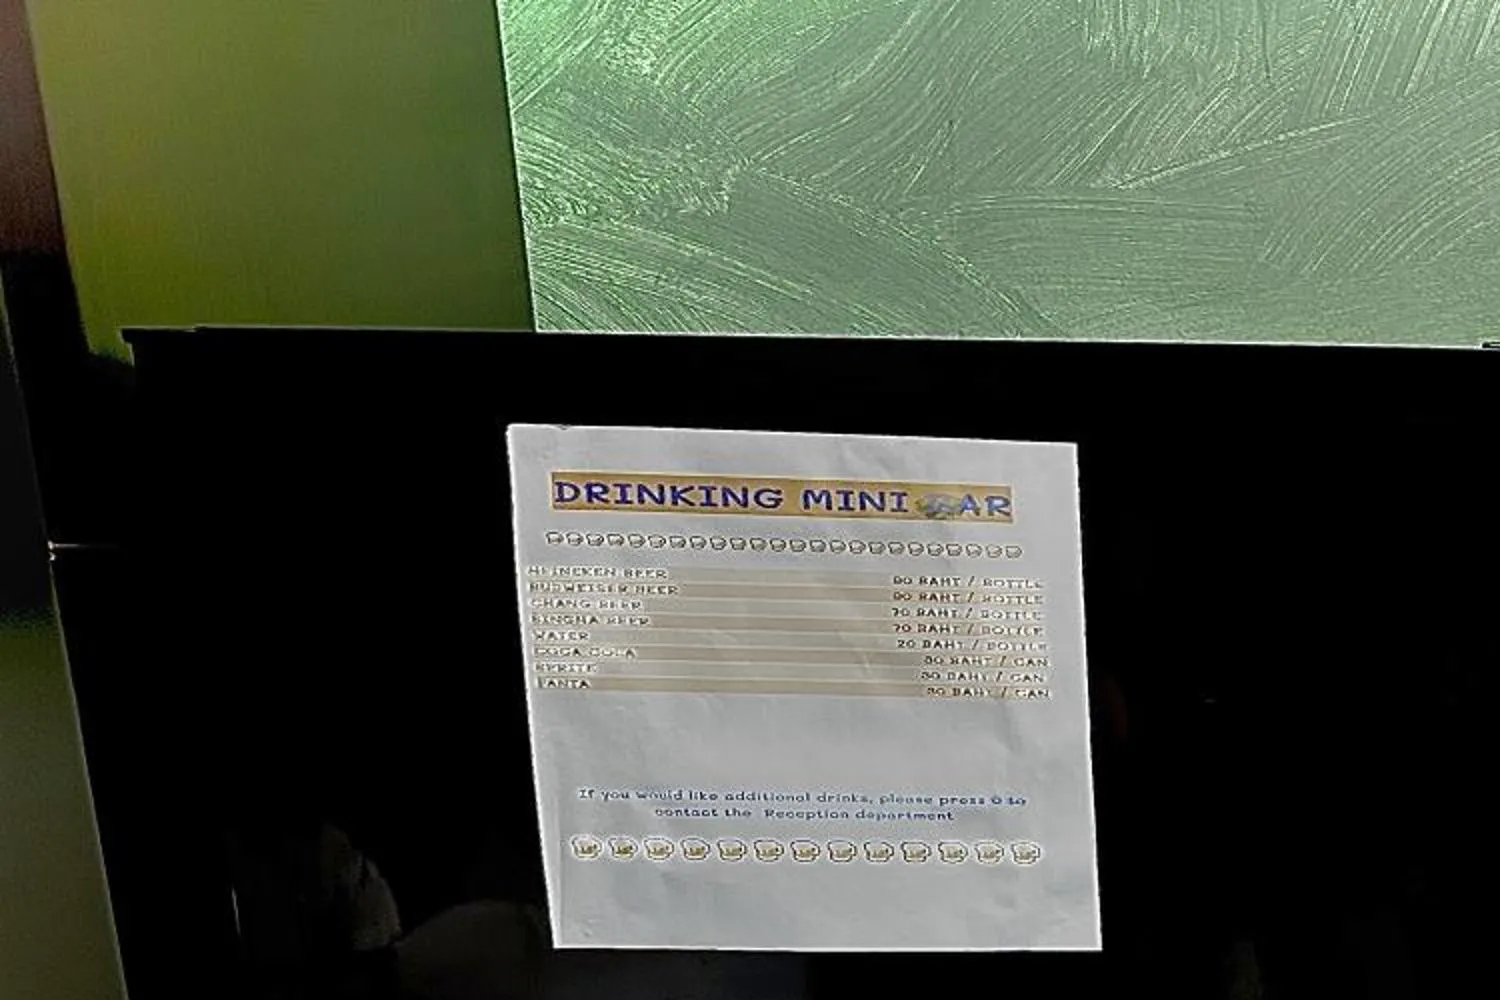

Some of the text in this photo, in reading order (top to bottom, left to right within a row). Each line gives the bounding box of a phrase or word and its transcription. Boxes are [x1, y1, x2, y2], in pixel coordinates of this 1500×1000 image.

[554, 481, 783, 509] DRINKING
[803, 489, 909, 513] MINI
[624, 568, 668, 579] BEER
[919, 577, 960, 586] BAHT
[983, 578, 1043, 589] BOTTLE
[919, 592, 960, 603] BAHT
[983, 594, 1043, 604] BOTTLE
[917, 608, 958, 618] BAHT
[981, 610, 1041, 620] BOTTLE
[533, 631, 589, 641] WATER
[918, 624, 959, 634] BAHT
[981, 625, 1043, 636] BOTTLE
[923, 640, 963, 650] BAHT
[987, 641, 1047, 651] BOTTLE
[950, 656, 992, 666] BAHT
[1014, 657, 1048, 667] CAN
[947, 672, 988, 682] BAHT
[1010, 673, 1044, 683] CAN
[952, 687, 992, 697] BAHT
[1016, 688, 1049, 699] CAN
[579, 789, 595, 799] If
[601, 791, 630, 802] you
[636, 790, 683, 800] would
[689, 790, 718, 801] like
[725, 791, 810, 802] additional
[817, 793, 874, 805] drinks,
[879, 793, 932, 806] please
[939, 796, 985, 807] press
[1009, 796, 1026, 806] to
[655, 807, 954, 821] contact the Reception department
